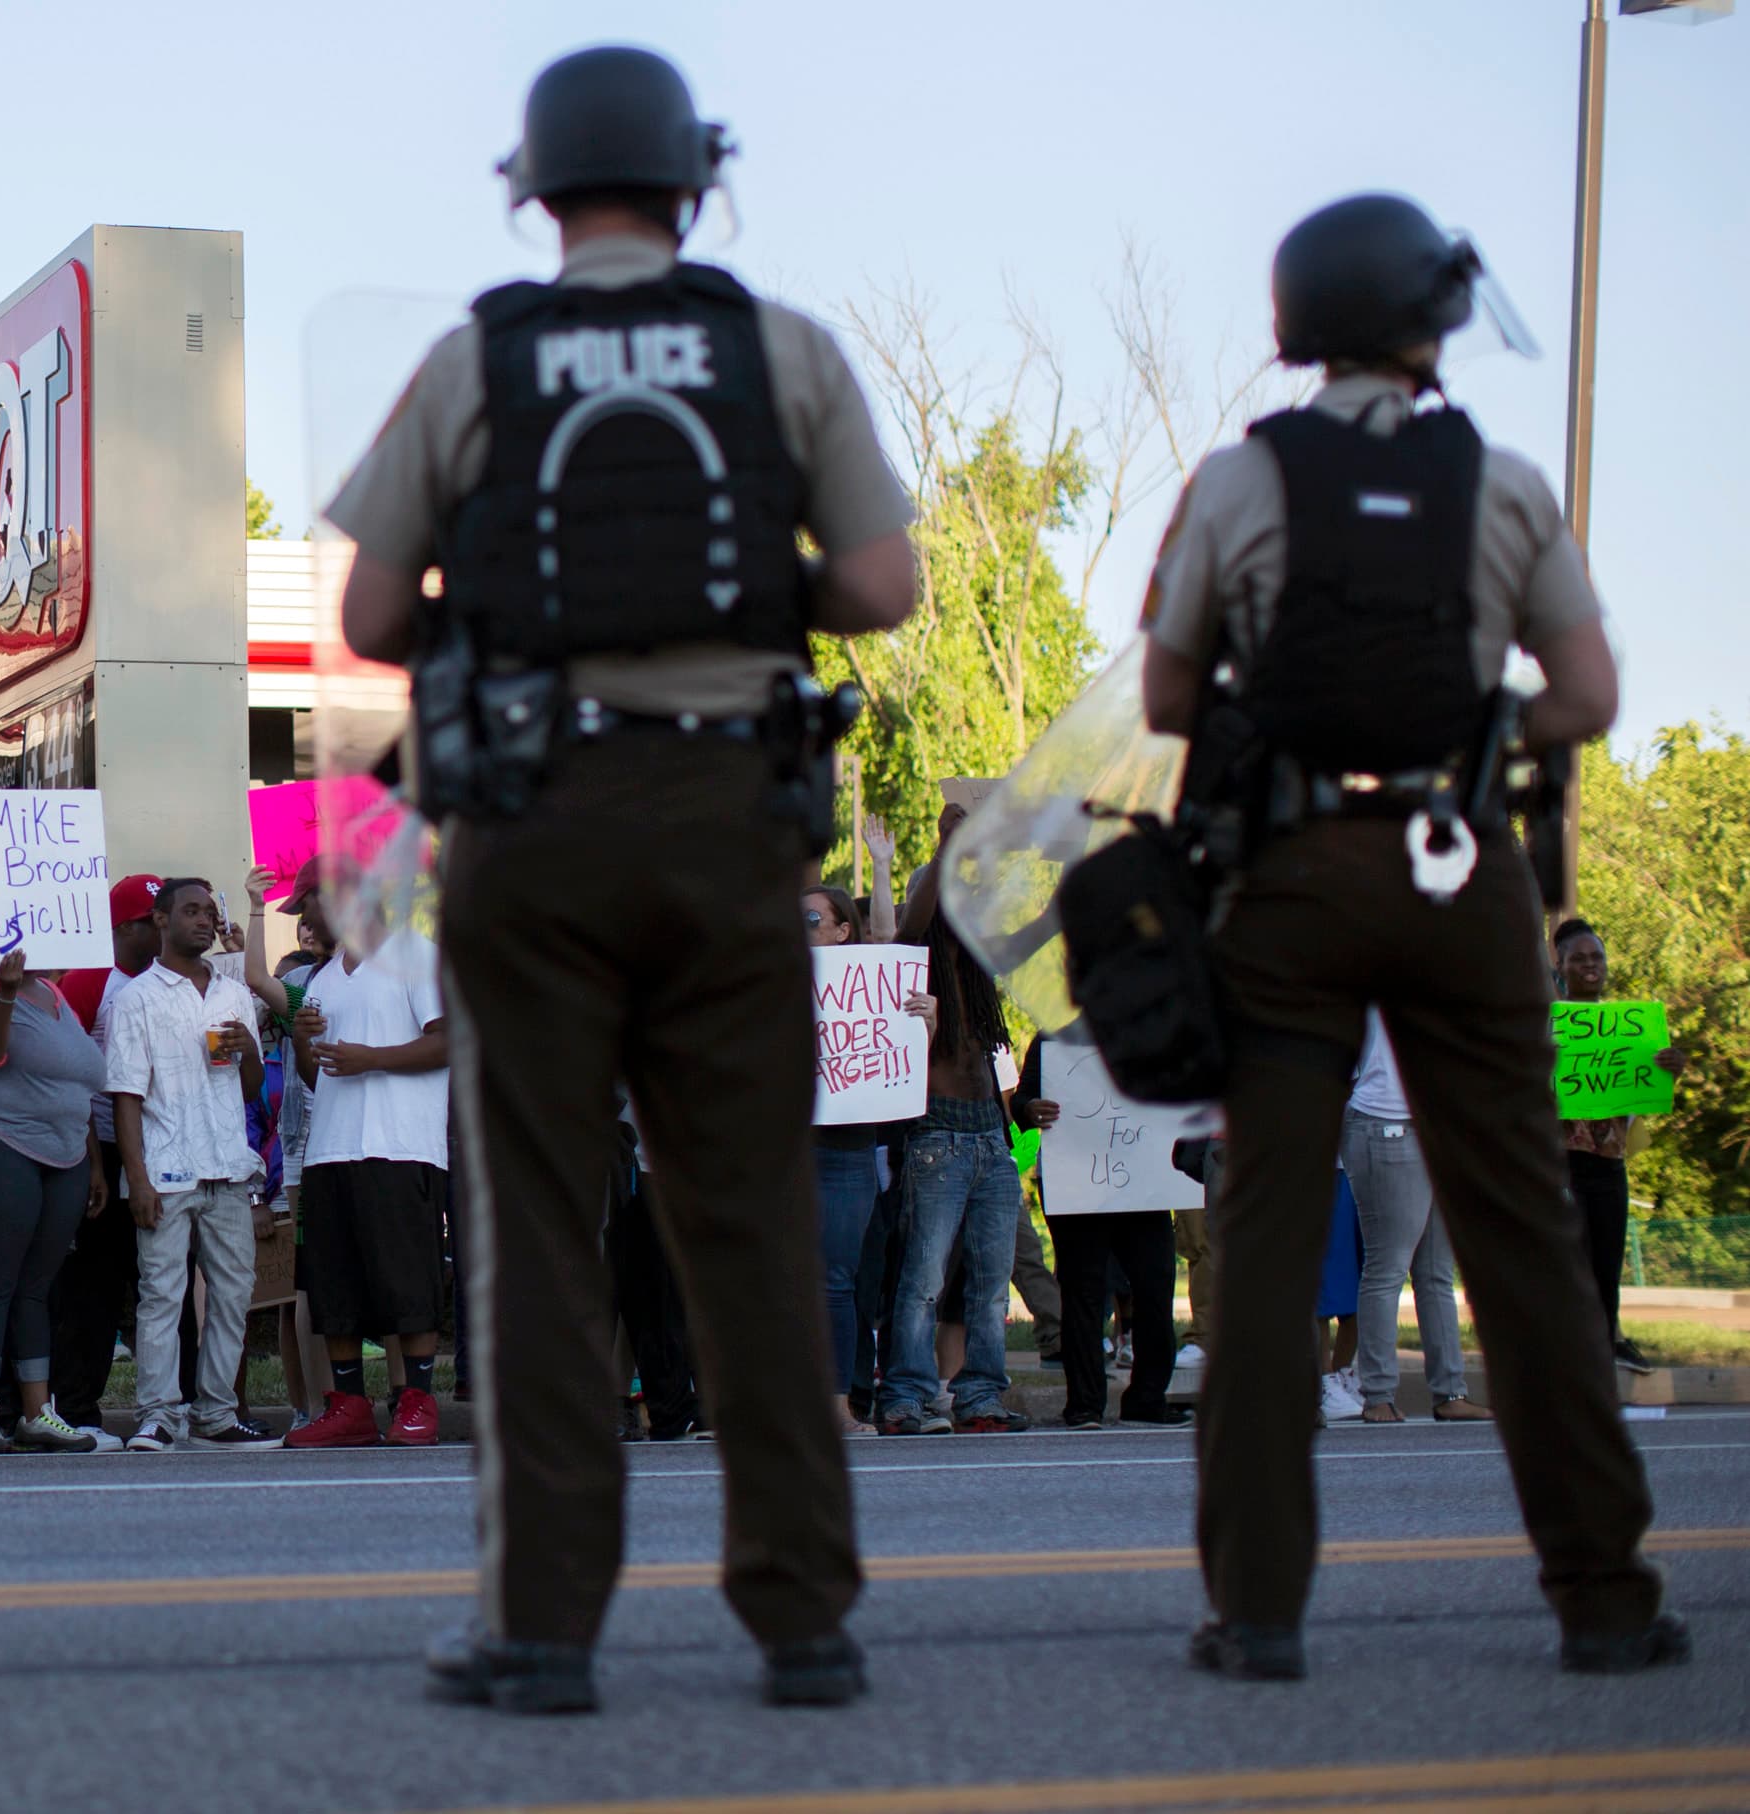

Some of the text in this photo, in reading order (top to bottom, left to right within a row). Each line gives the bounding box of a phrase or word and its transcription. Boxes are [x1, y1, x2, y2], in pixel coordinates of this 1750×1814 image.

[536, 322, 716, 397] POLICE
[5, 846, 108, 887] Brown
[812, 960, 928, 1015] WANT
[816, 1017, 894, 1057] RDER
[1550, 1008, 1645, 1040] ESUS
[816, 1045, 911, 1095] ARGE!!!
[1564, 1046, 1634, 1073] THE
[1553, 1065, 1656, 1097] SWER
[1106, 1115, 1147, 1149] For
